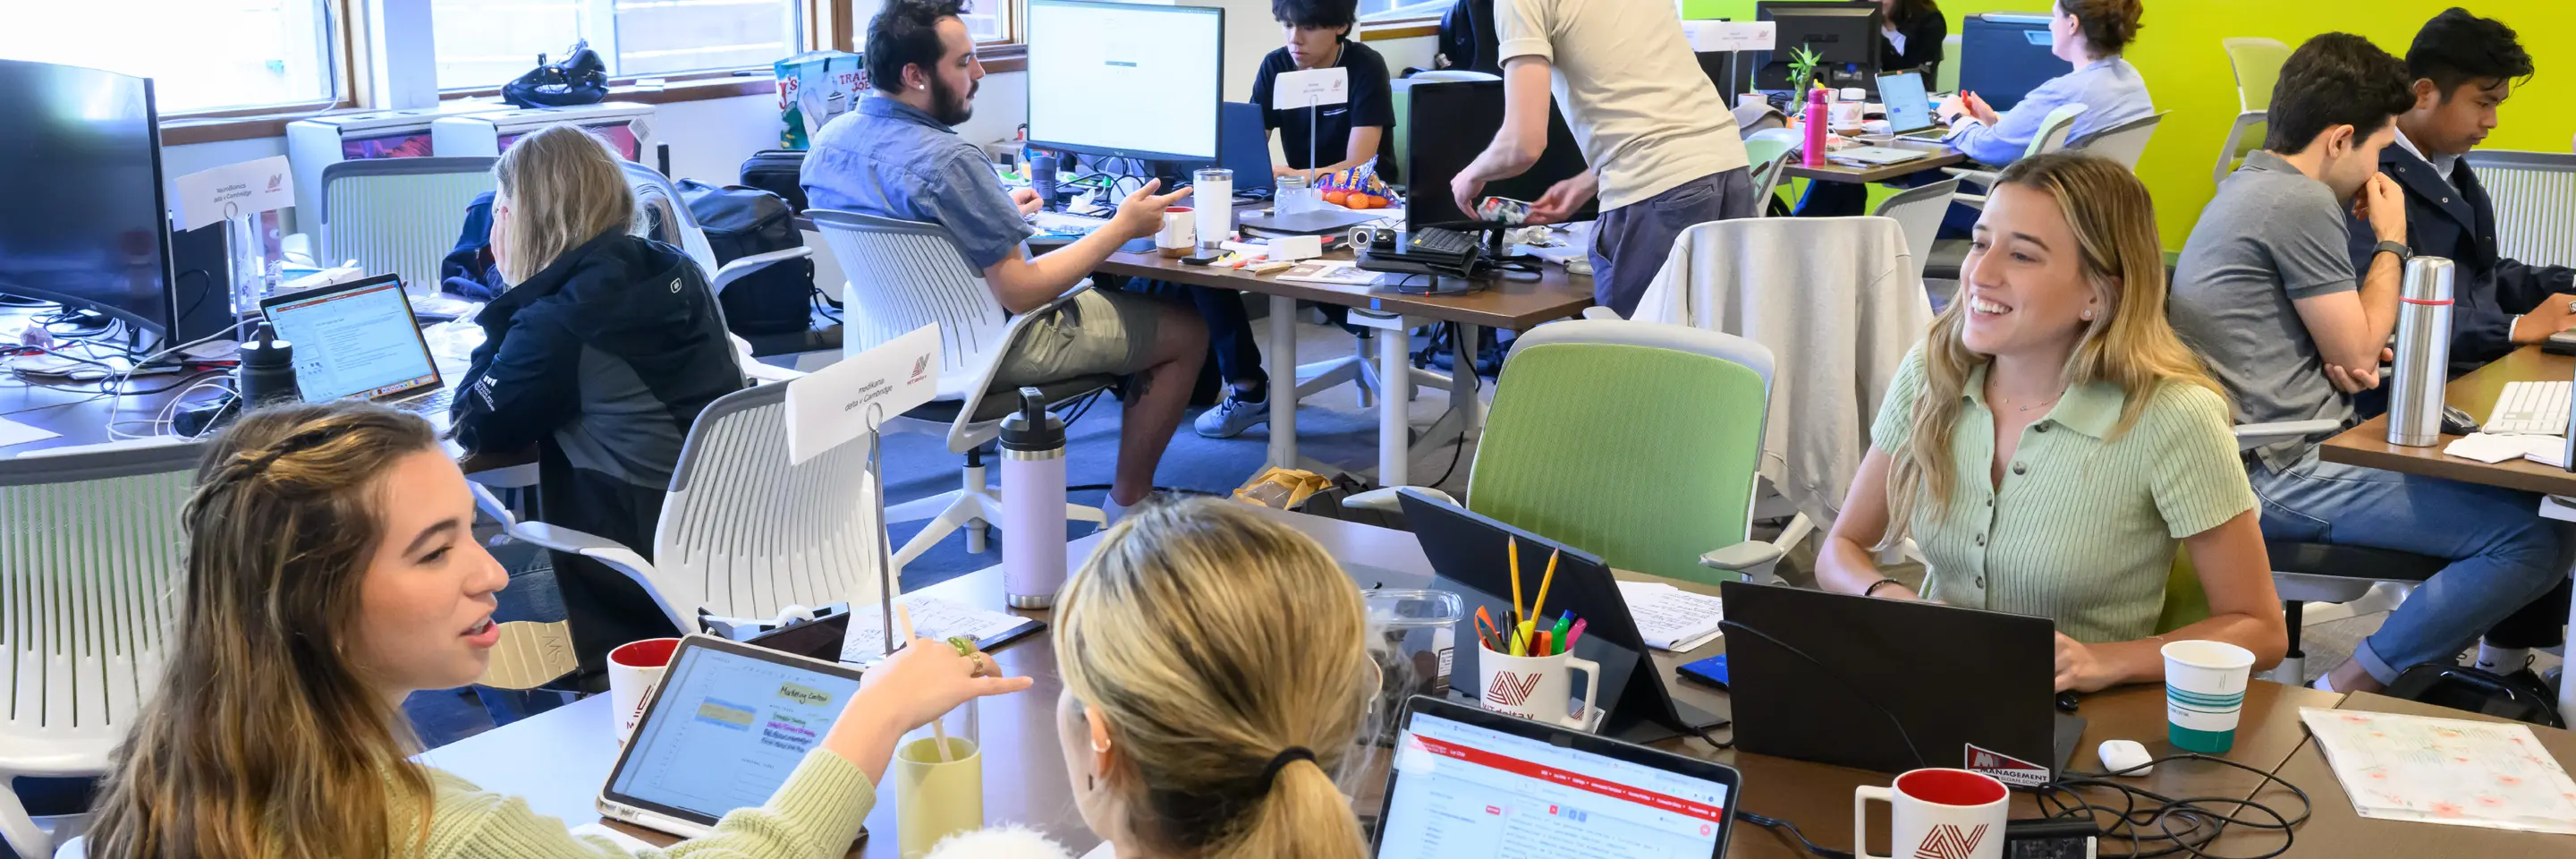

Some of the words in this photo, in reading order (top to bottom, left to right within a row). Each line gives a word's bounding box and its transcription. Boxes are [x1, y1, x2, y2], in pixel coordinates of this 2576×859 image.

[852, 81, 871, 92] JOE
[864, 385, 893, 403] Cambridge
[1979, 769, 2047, 782] MANAGEMENT
[2001, 776, 2021, 784] SLOAN
[2022, 778, 2040, 787] SCHO
